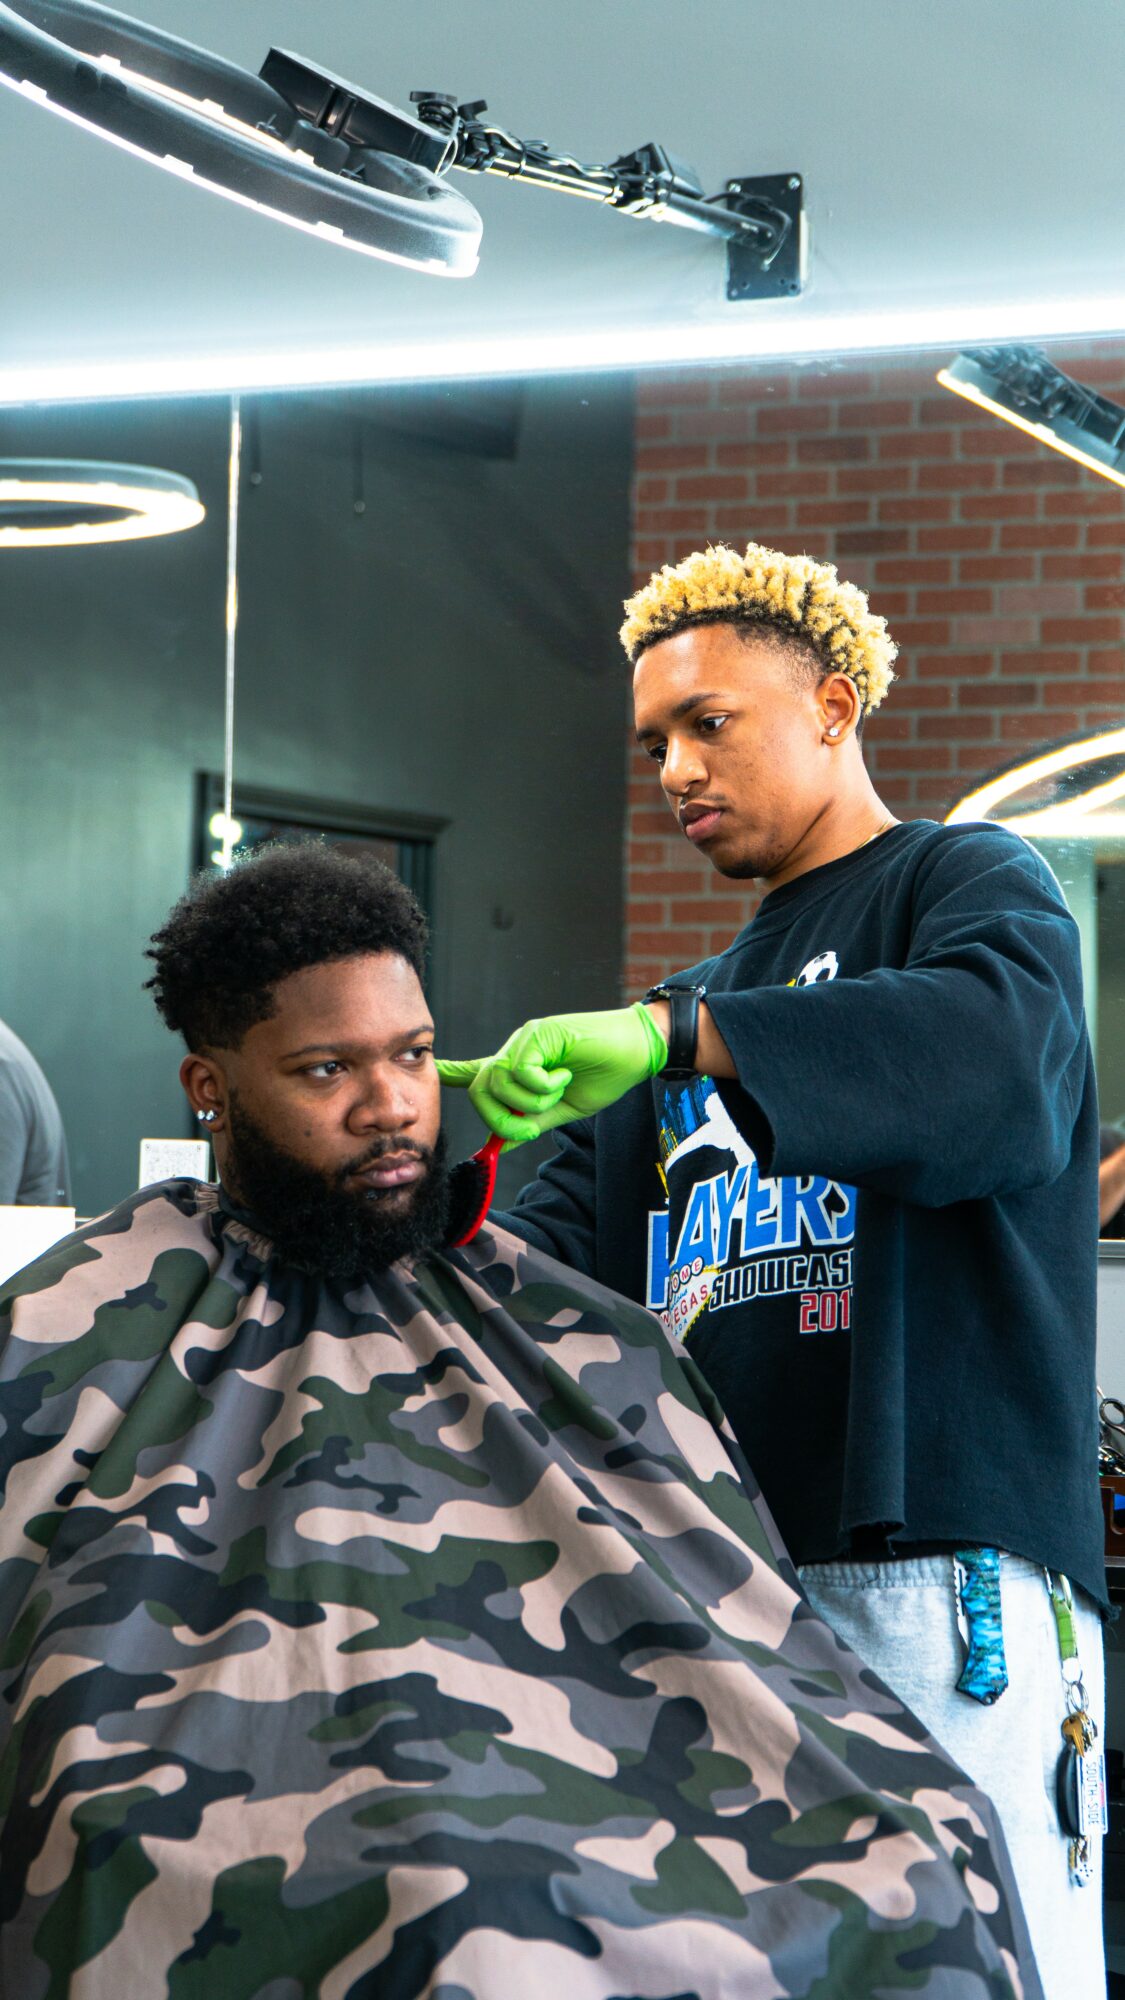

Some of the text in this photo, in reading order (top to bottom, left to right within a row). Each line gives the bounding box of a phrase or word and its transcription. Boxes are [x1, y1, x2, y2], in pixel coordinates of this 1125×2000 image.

[709, 1247, 855, 1312] SHOWCAS
[671, 1284, 708, 1326] EGAS
[800, 1288, 853, 1333] 201
